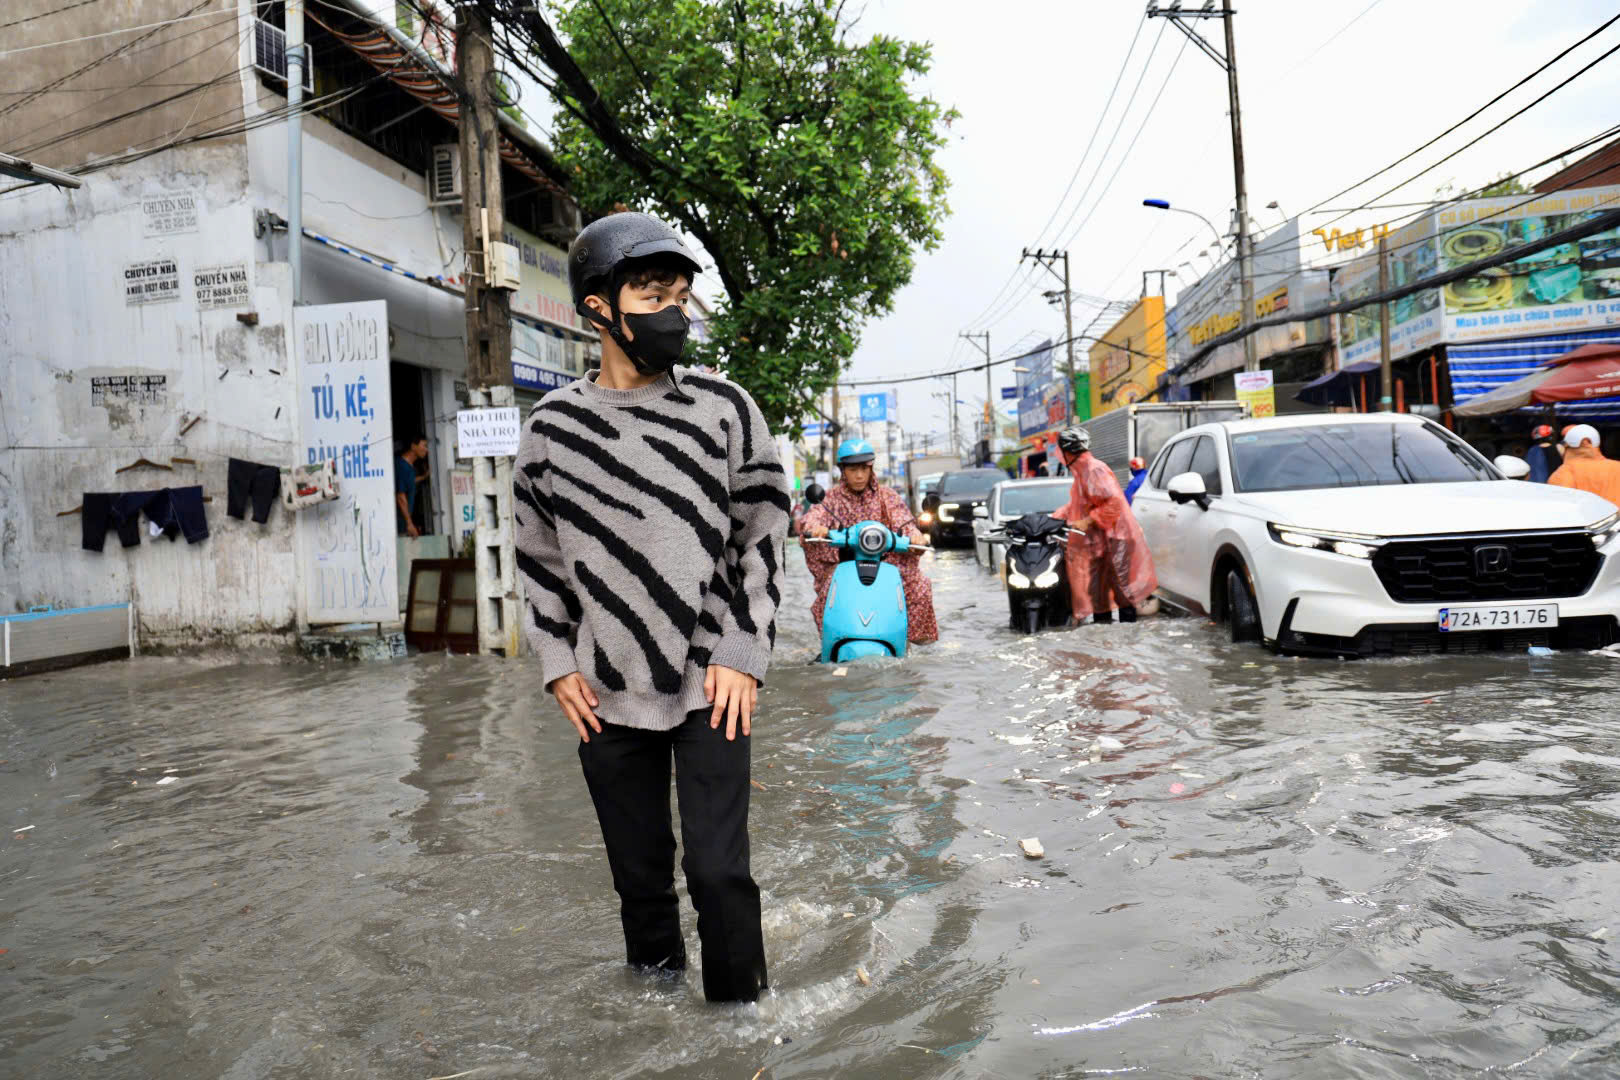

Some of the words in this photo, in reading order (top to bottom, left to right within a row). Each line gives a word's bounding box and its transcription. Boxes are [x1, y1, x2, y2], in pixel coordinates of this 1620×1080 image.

[196, 289, 210, 299] 077
[212, 287, 232, 297] 8888
[1456, 318, 1478, 328] Mua
[312, 373, 340, 424] TỦ,
[344, 376, 374, 424] KỆ,
[459, 414, 484, 423] CHO
[464, 424, 488, 438] NHÀ
[492, 426, 516, 438] TRỌ
[1450, 609, 1548, 626] 72A-731.76
